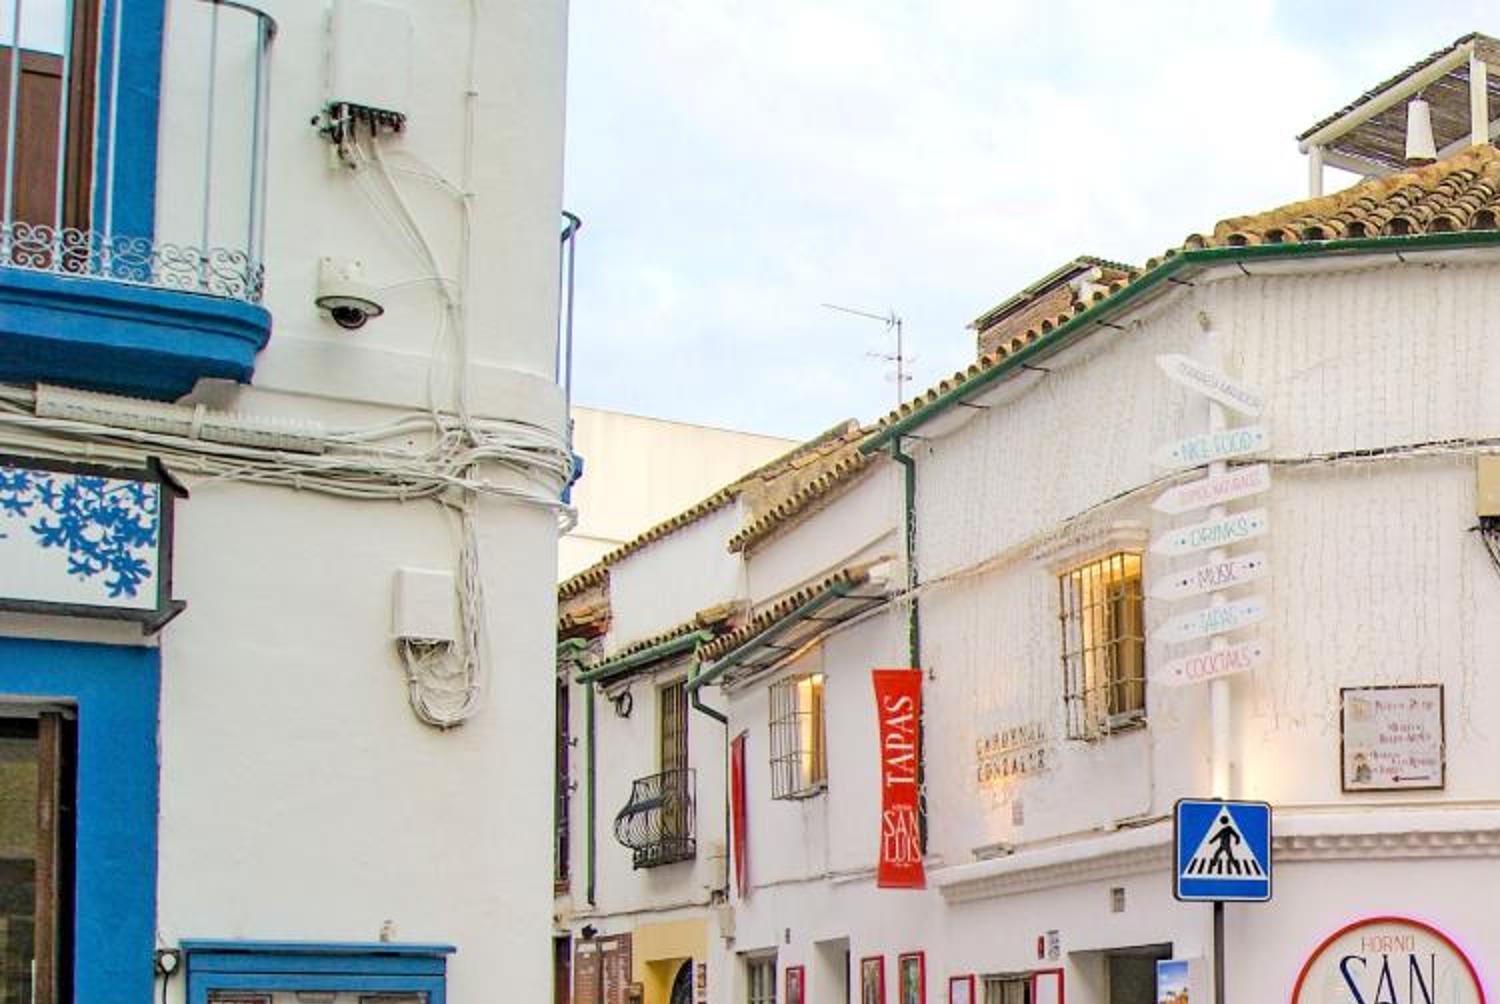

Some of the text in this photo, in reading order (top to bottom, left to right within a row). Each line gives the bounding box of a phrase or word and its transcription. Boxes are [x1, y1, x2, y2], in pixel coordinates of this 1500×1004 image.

[1191, 516, 1249, 546] DRINKS
[883, 694, 916, 788] TAPAS
[883, 809, 921, 837] SAN
[884, 835, 922, 864] LUIS
[1360, 935, 1416, 953] HORNO
